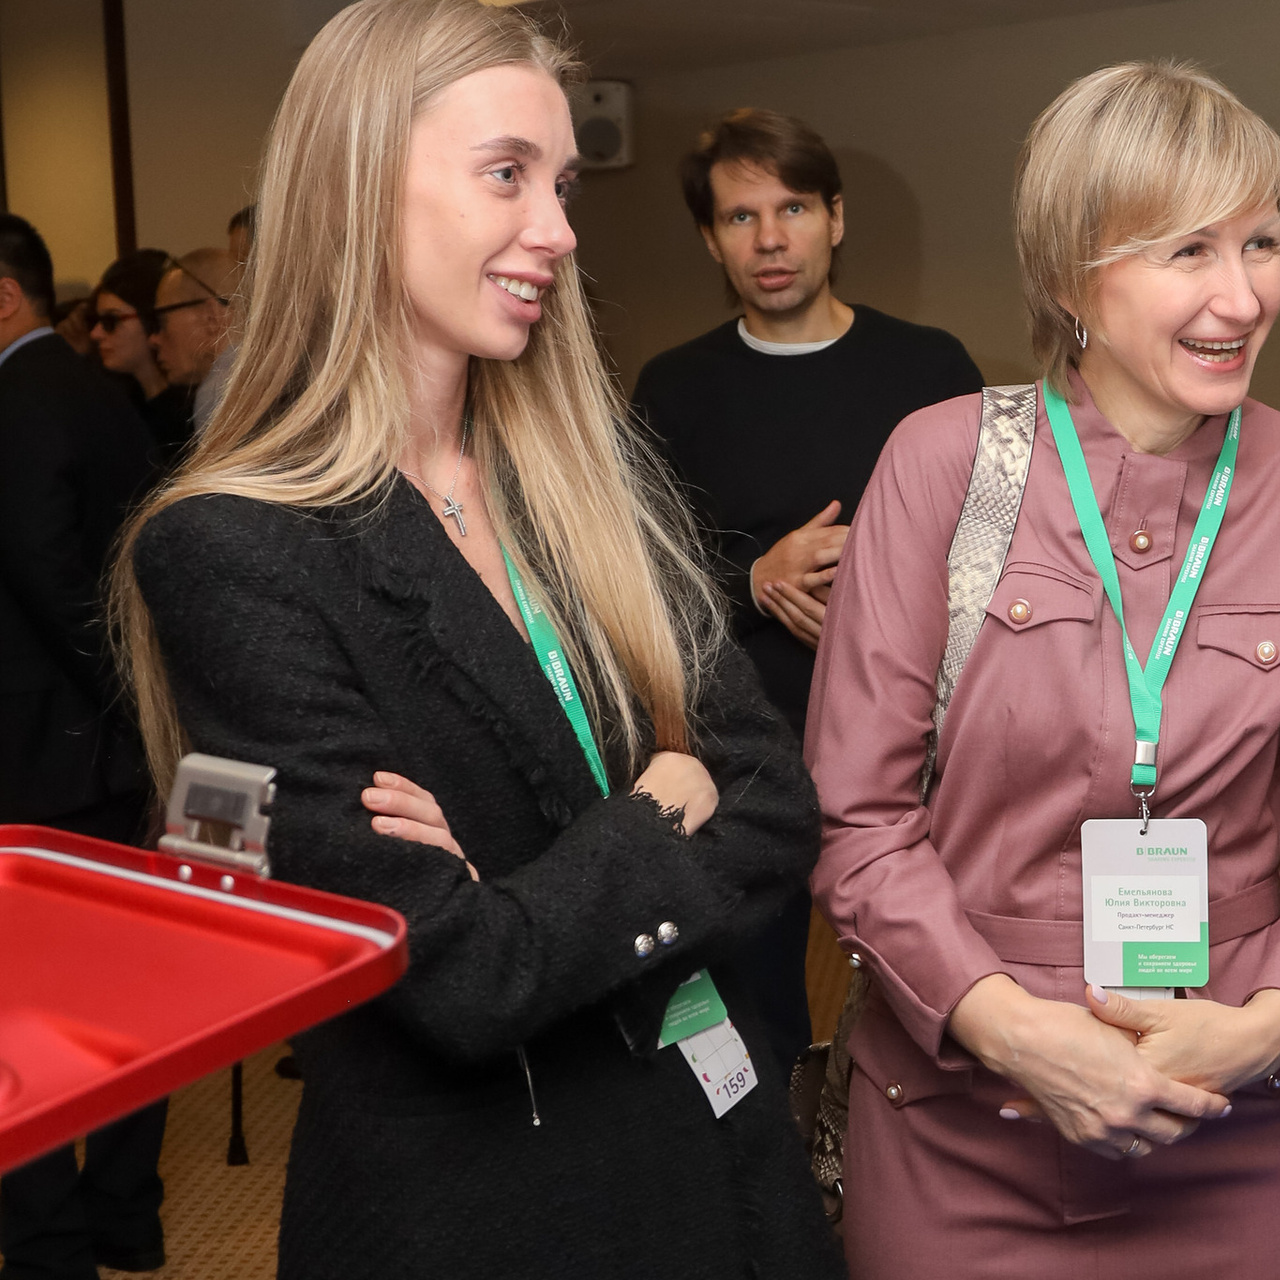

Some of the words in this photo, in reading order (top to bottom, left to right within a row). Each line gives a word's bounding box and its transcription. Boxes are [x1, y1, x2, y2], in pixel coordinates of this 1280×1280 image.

[1118, 887, 1173, 896] Емельянова
[1105, 898, 1131, 907] Юлия
[1133, 898, 1187, 909] Викторовна
[1118, 923, 1164, 931] Санкт-Петербург
[722, 1071, 746, 1099] 159
